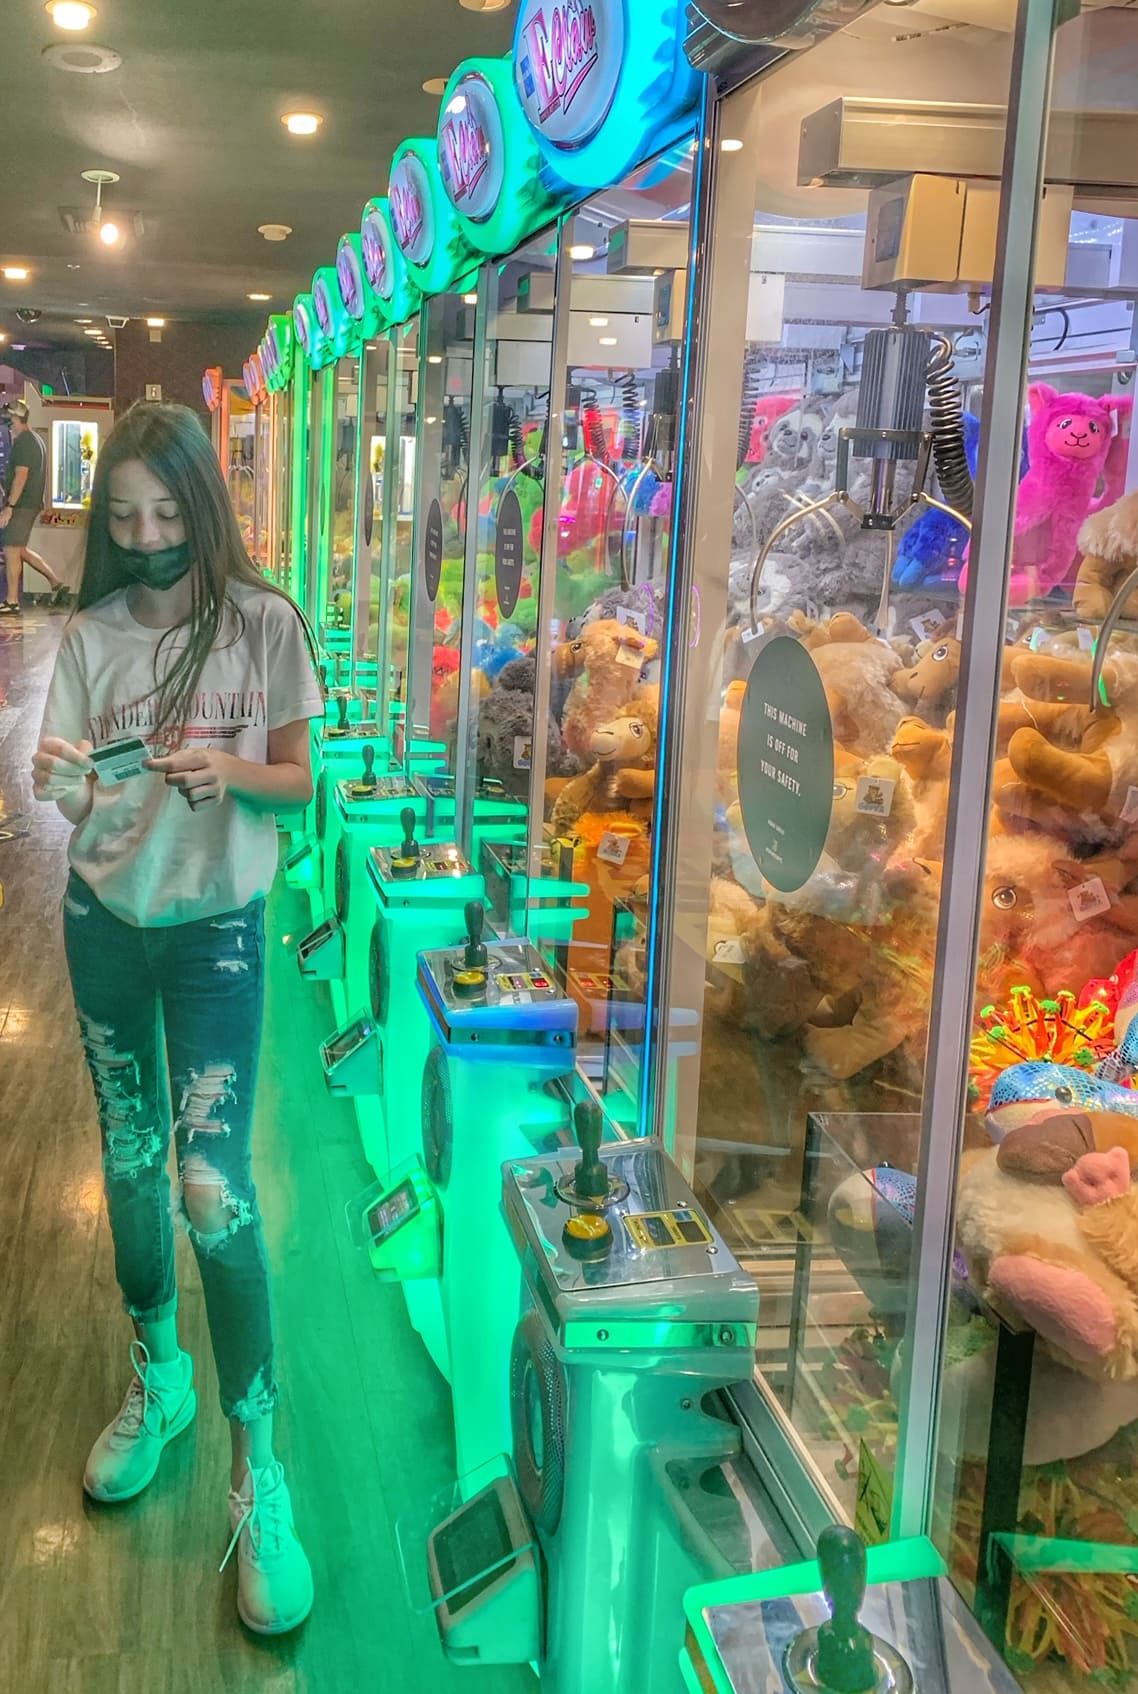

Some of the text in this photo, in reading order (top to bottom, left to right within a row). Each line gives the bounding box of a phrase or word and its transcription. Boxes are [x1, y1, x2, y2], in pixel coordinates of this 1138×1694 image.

[763, 702, 807, 737] THIS MACHINE
[767, 733, 799, 764] IS OFF FOR
[760, 760, 801, 797] YOUR SAFETY.
